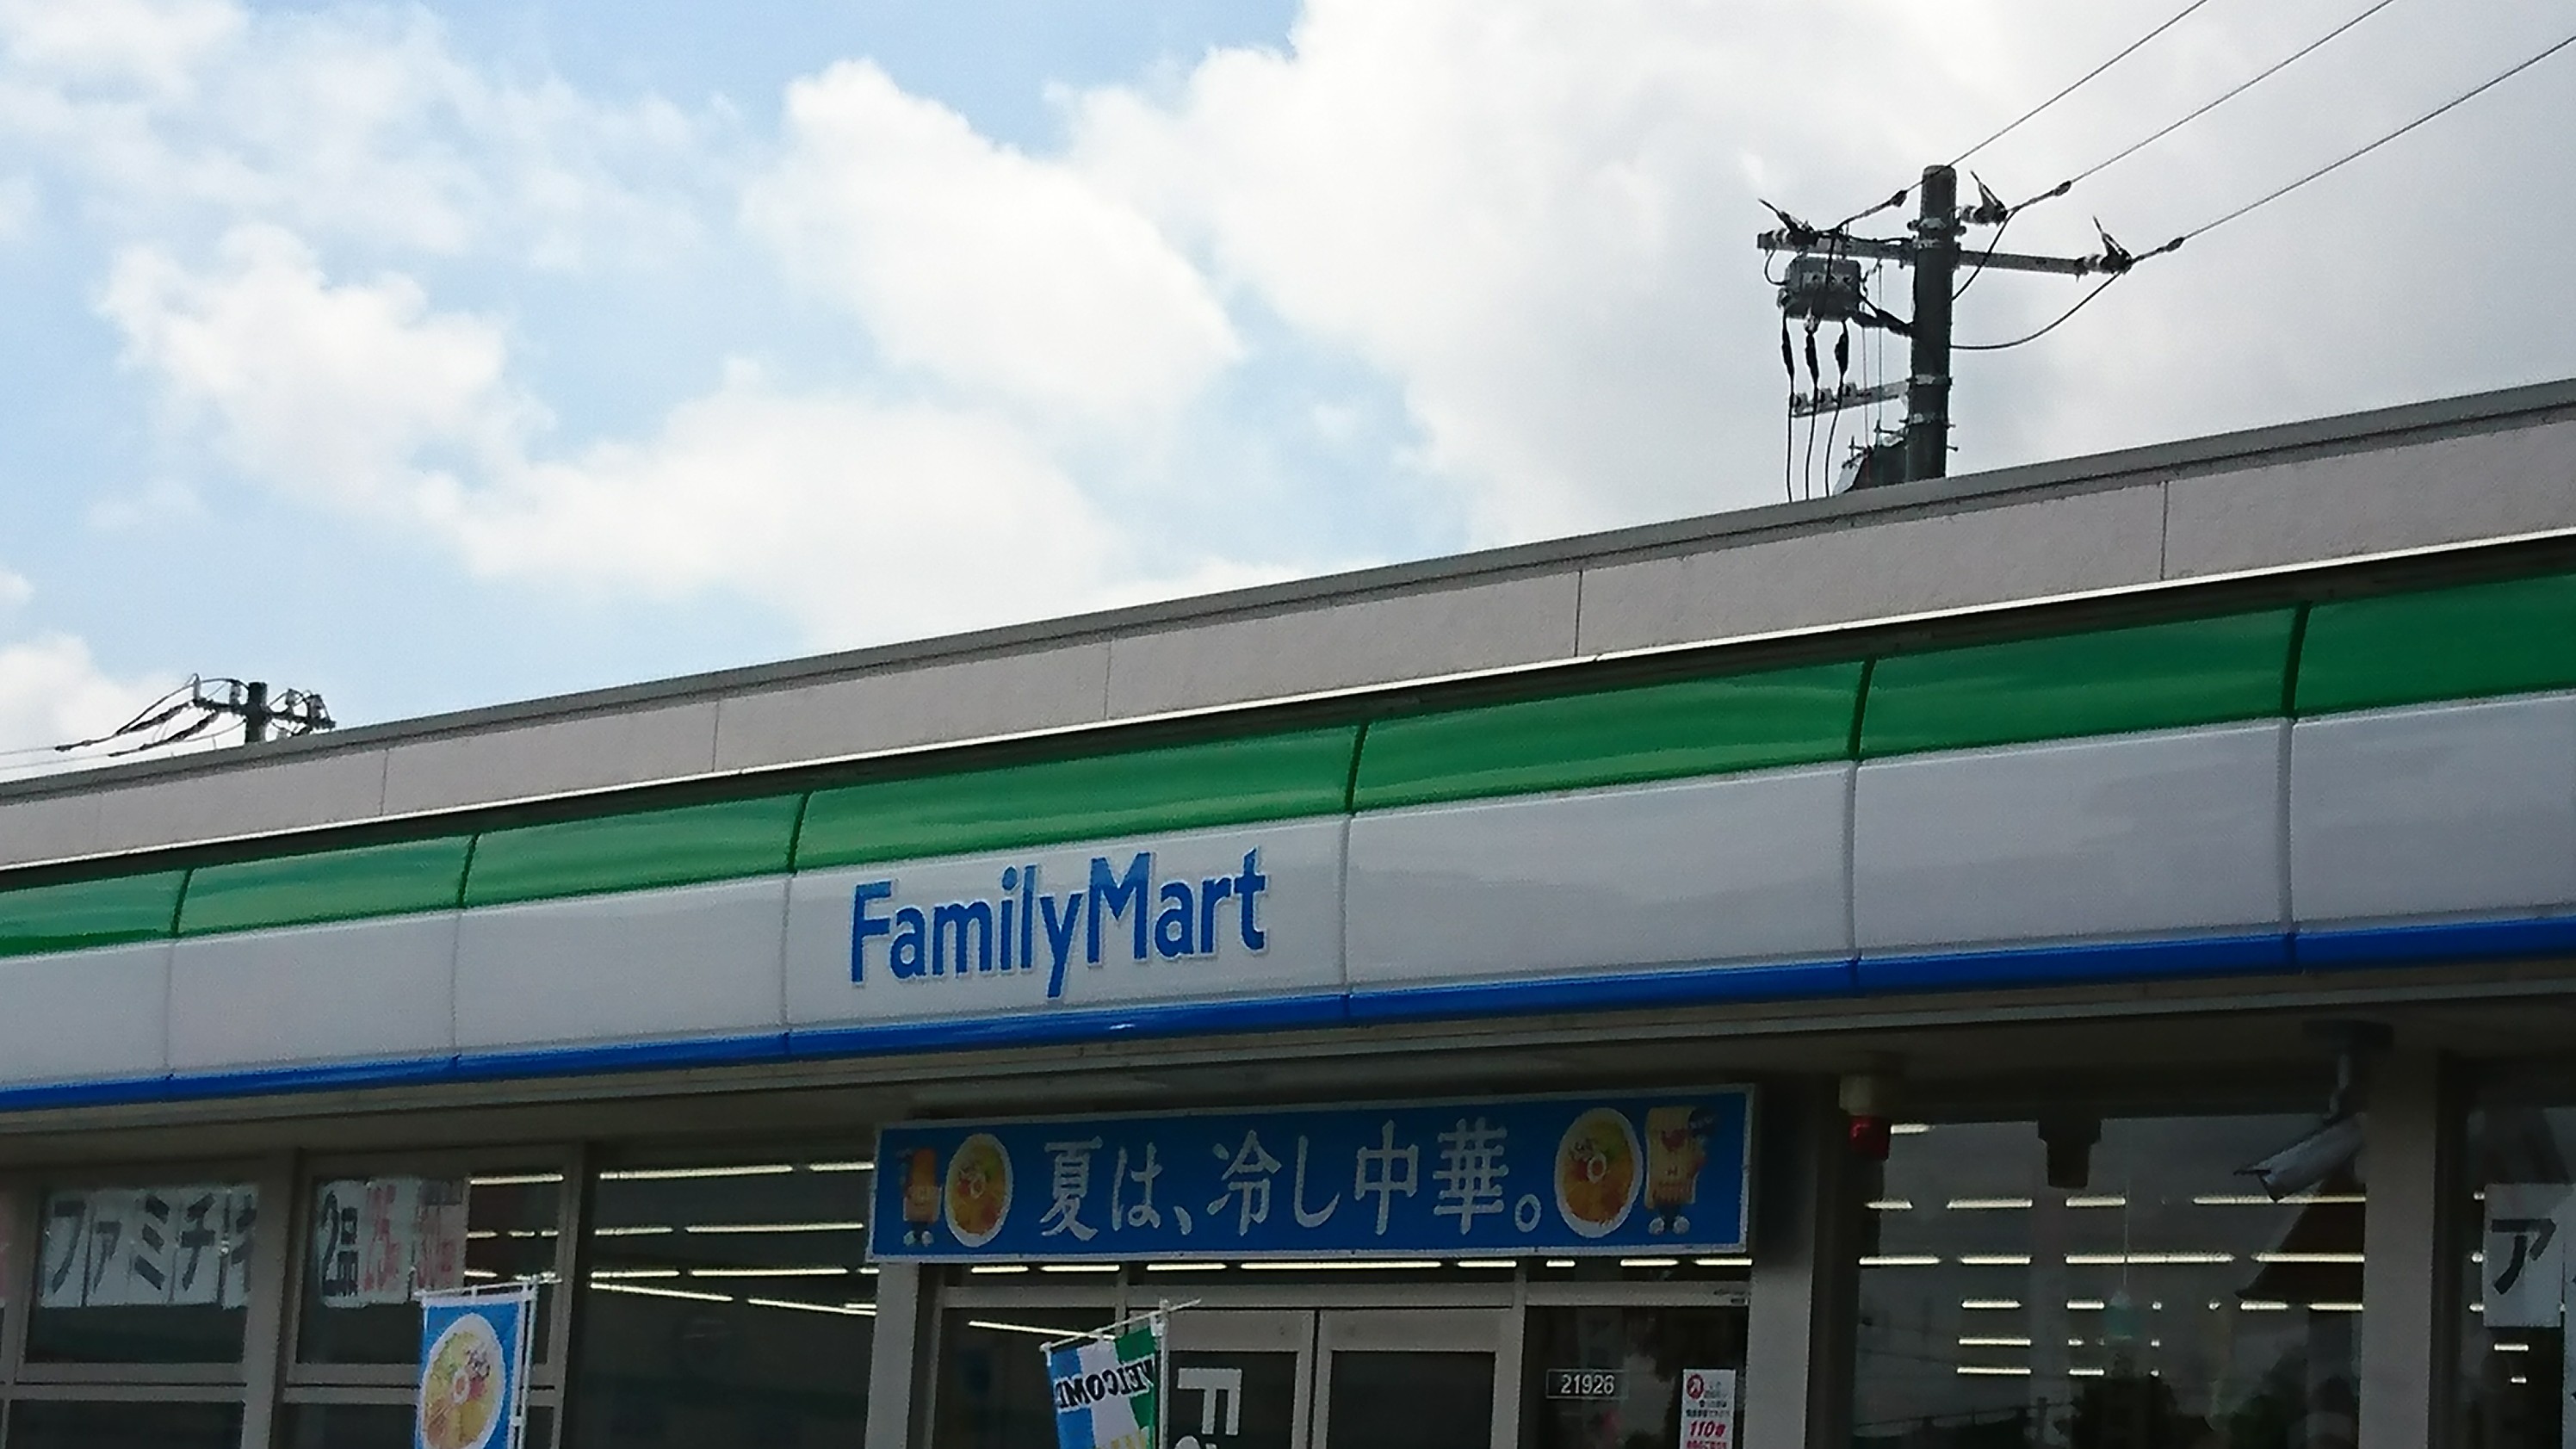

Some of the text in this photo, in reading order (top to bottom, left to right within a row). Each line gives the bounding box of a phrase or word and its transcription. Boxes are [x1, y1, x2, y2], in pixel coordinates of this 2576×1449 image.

[851, 847, 1267, 999] FamilyMart
[1039, 1119, 1541, 1242] 夏は、冷し中華。
